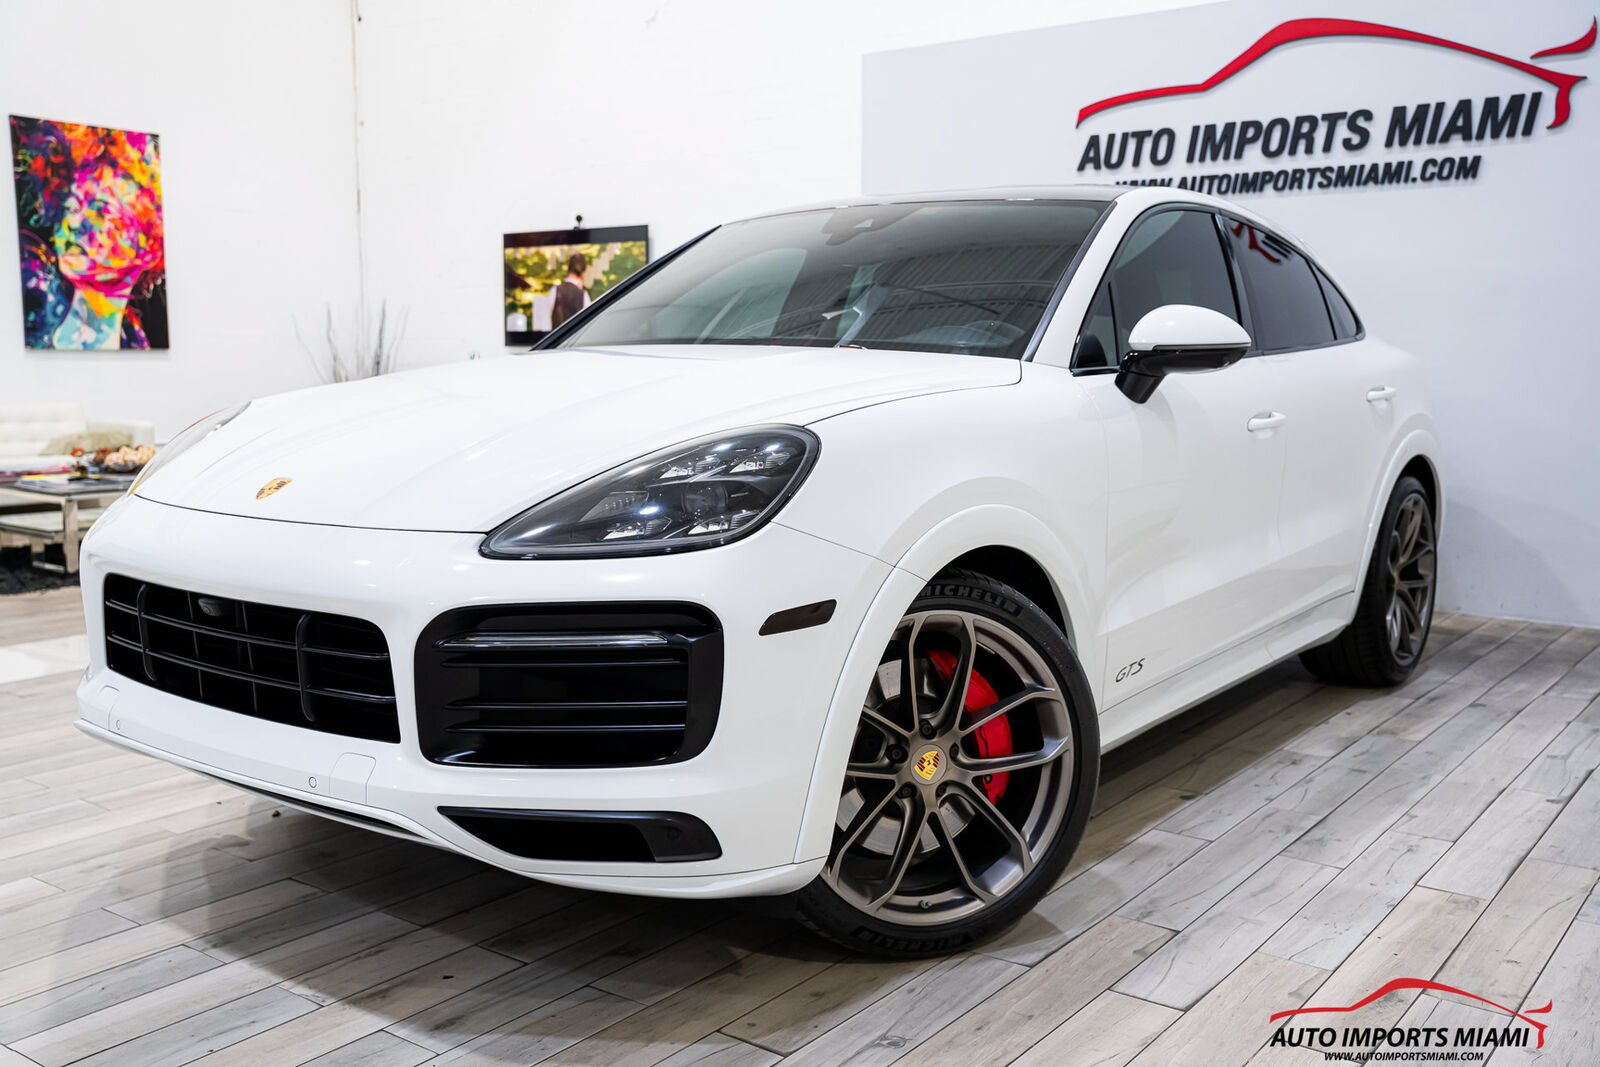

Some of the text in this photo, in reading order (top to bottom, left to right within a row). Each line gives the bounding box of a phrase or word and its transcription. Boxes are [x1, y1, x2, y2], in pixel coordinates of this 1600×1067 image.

[1077, 92, 1543, 172] AUTO IMPORTS MIAMI
[1116, 155, 1482, 195] AUTOIMPORTSMIAMI.COM
[920, 585, 1018, 613] MICHELIN
[1115, 657, 1146, 682] GTS
